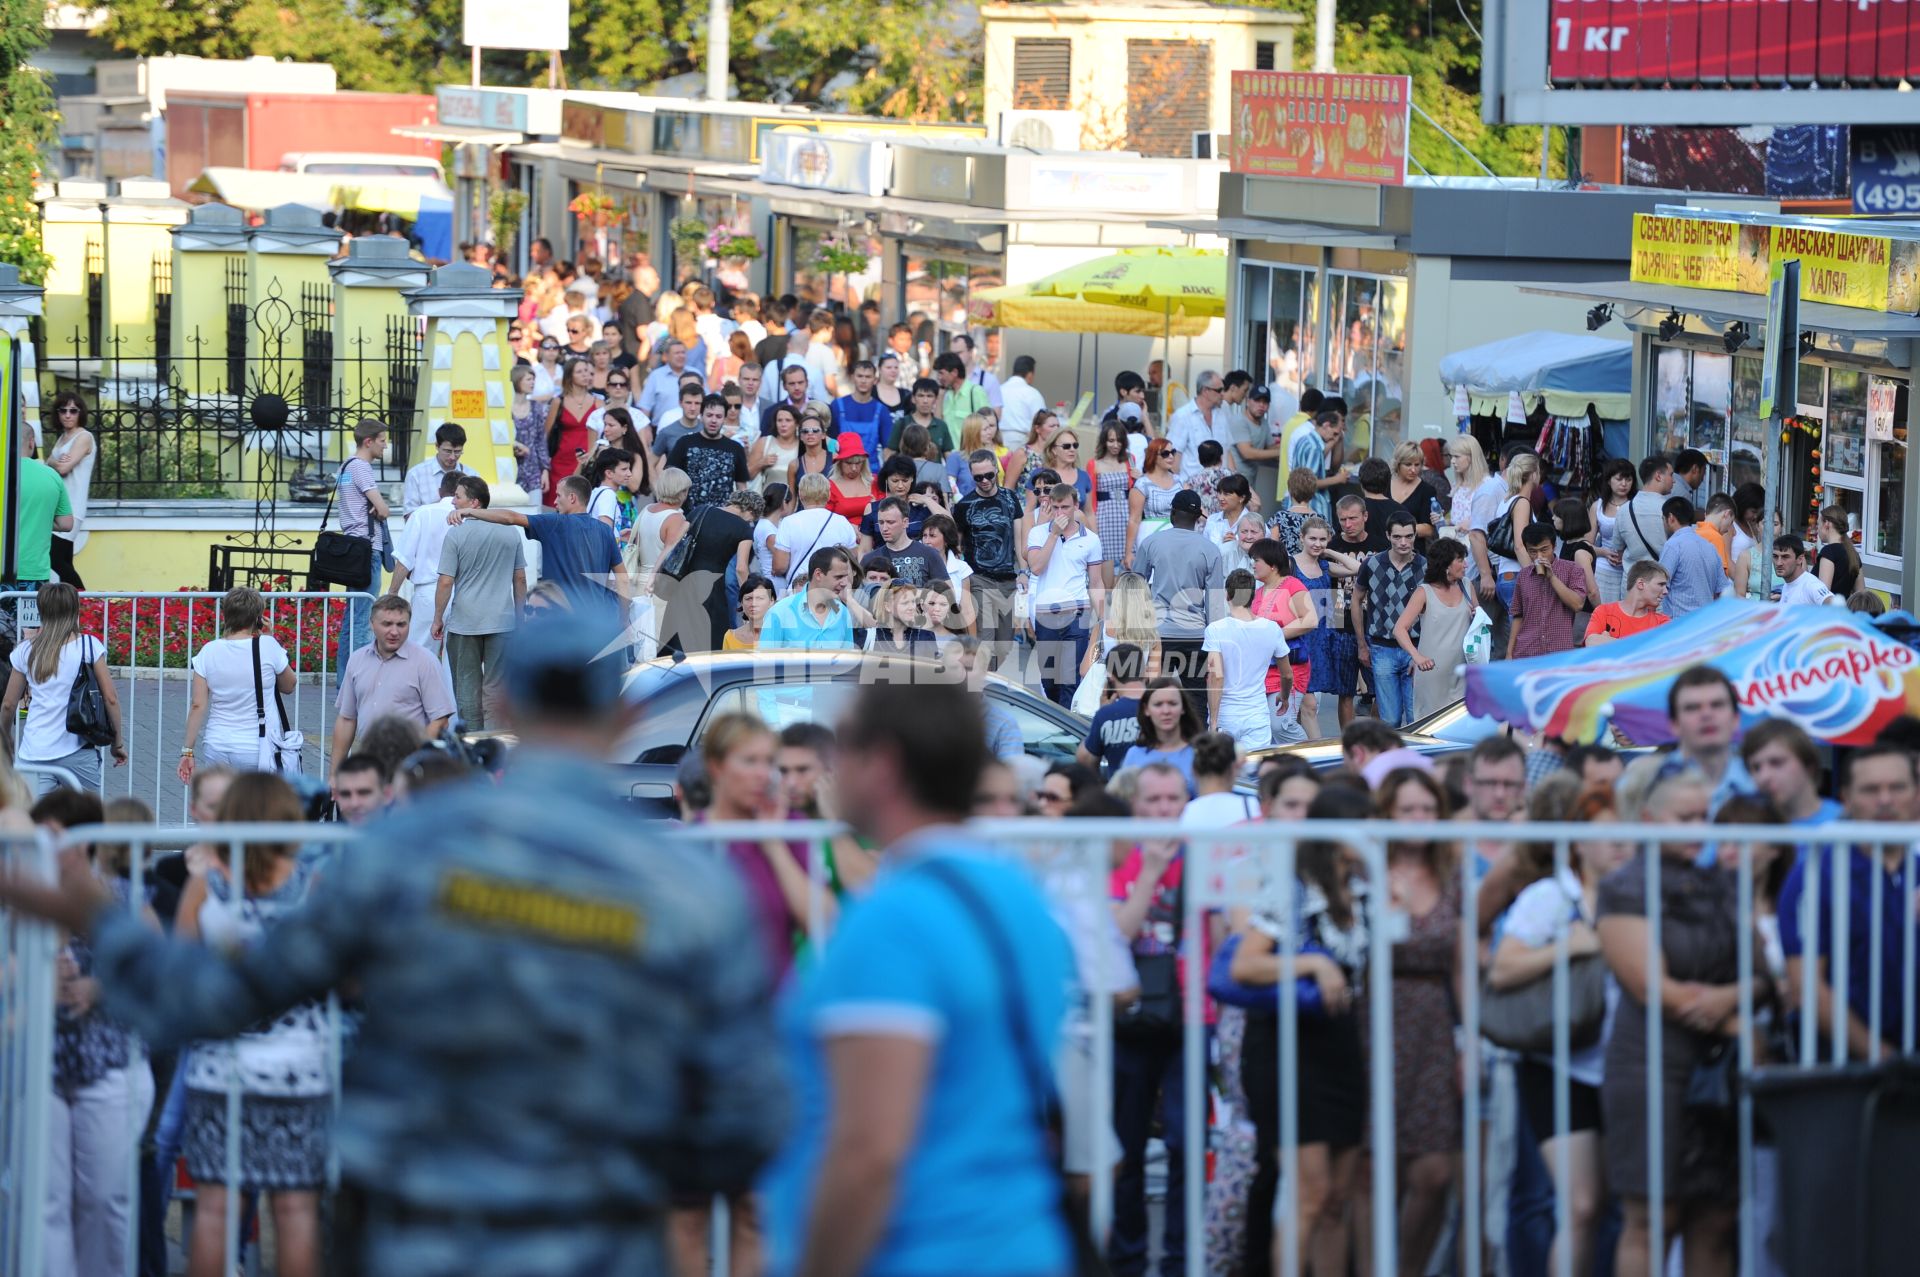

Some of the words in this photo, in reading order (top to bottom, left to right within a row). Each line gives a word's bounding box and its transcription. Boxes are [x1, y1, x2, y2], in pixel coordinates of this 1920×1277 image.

[1556, 17, 1572, 51] 1
[1584, 26, 1630, 51] кг
[1640, 216, 1681, 244] СВЕЖАЯ
[1684, 219, 1733, 246] ВЫПЕЧКА
[1776, 227, 1835, 259] АРАБСКАЯ
[1837, 233, 1885, 266] ШАУРМА
[1637, 250, 1680, 279] ГОРЯЧИЕ
